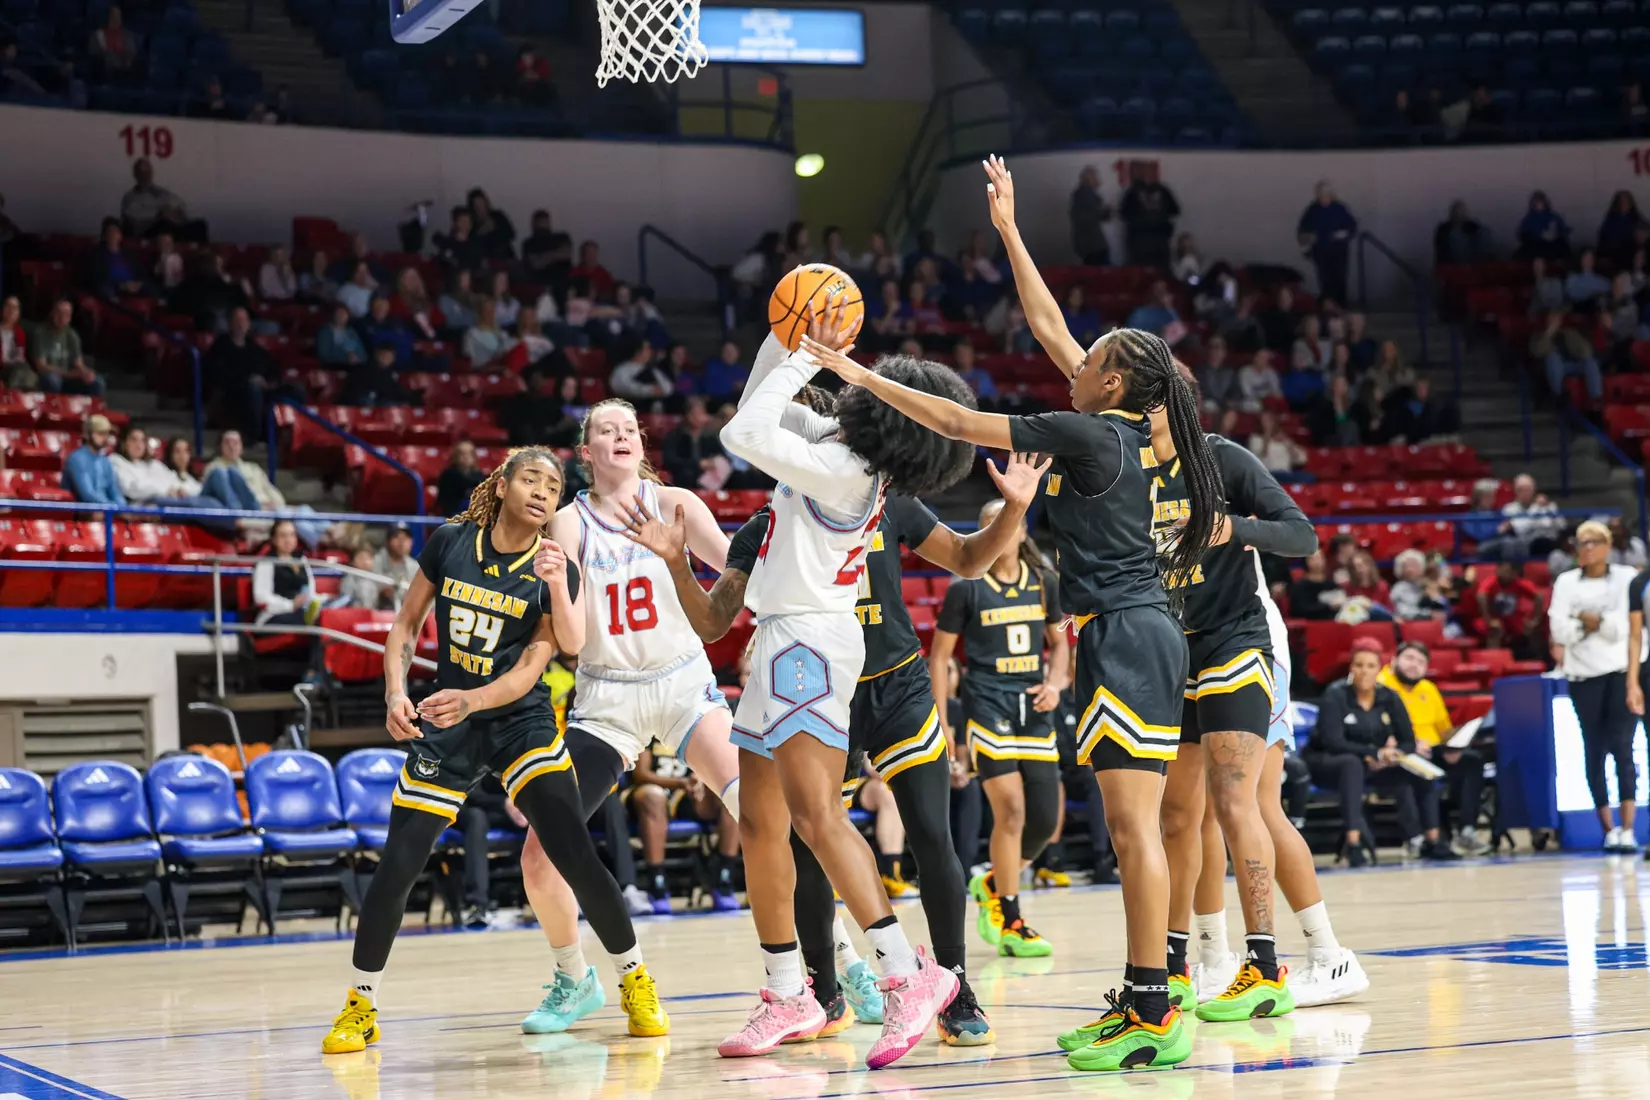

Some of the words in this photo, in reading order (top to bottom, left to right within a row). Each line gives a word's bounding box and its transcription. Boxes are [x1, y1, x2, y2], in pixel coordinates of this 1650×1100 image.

[119, 123, 174, 160] 119
[441, 576, 529, 619] KENNESAW
[606, 576, 659, 635] 18
[449, 604, 505, 653] 24
[1006, 623, 1031, 655] 0
[449, 643, 494, 677] STATE
